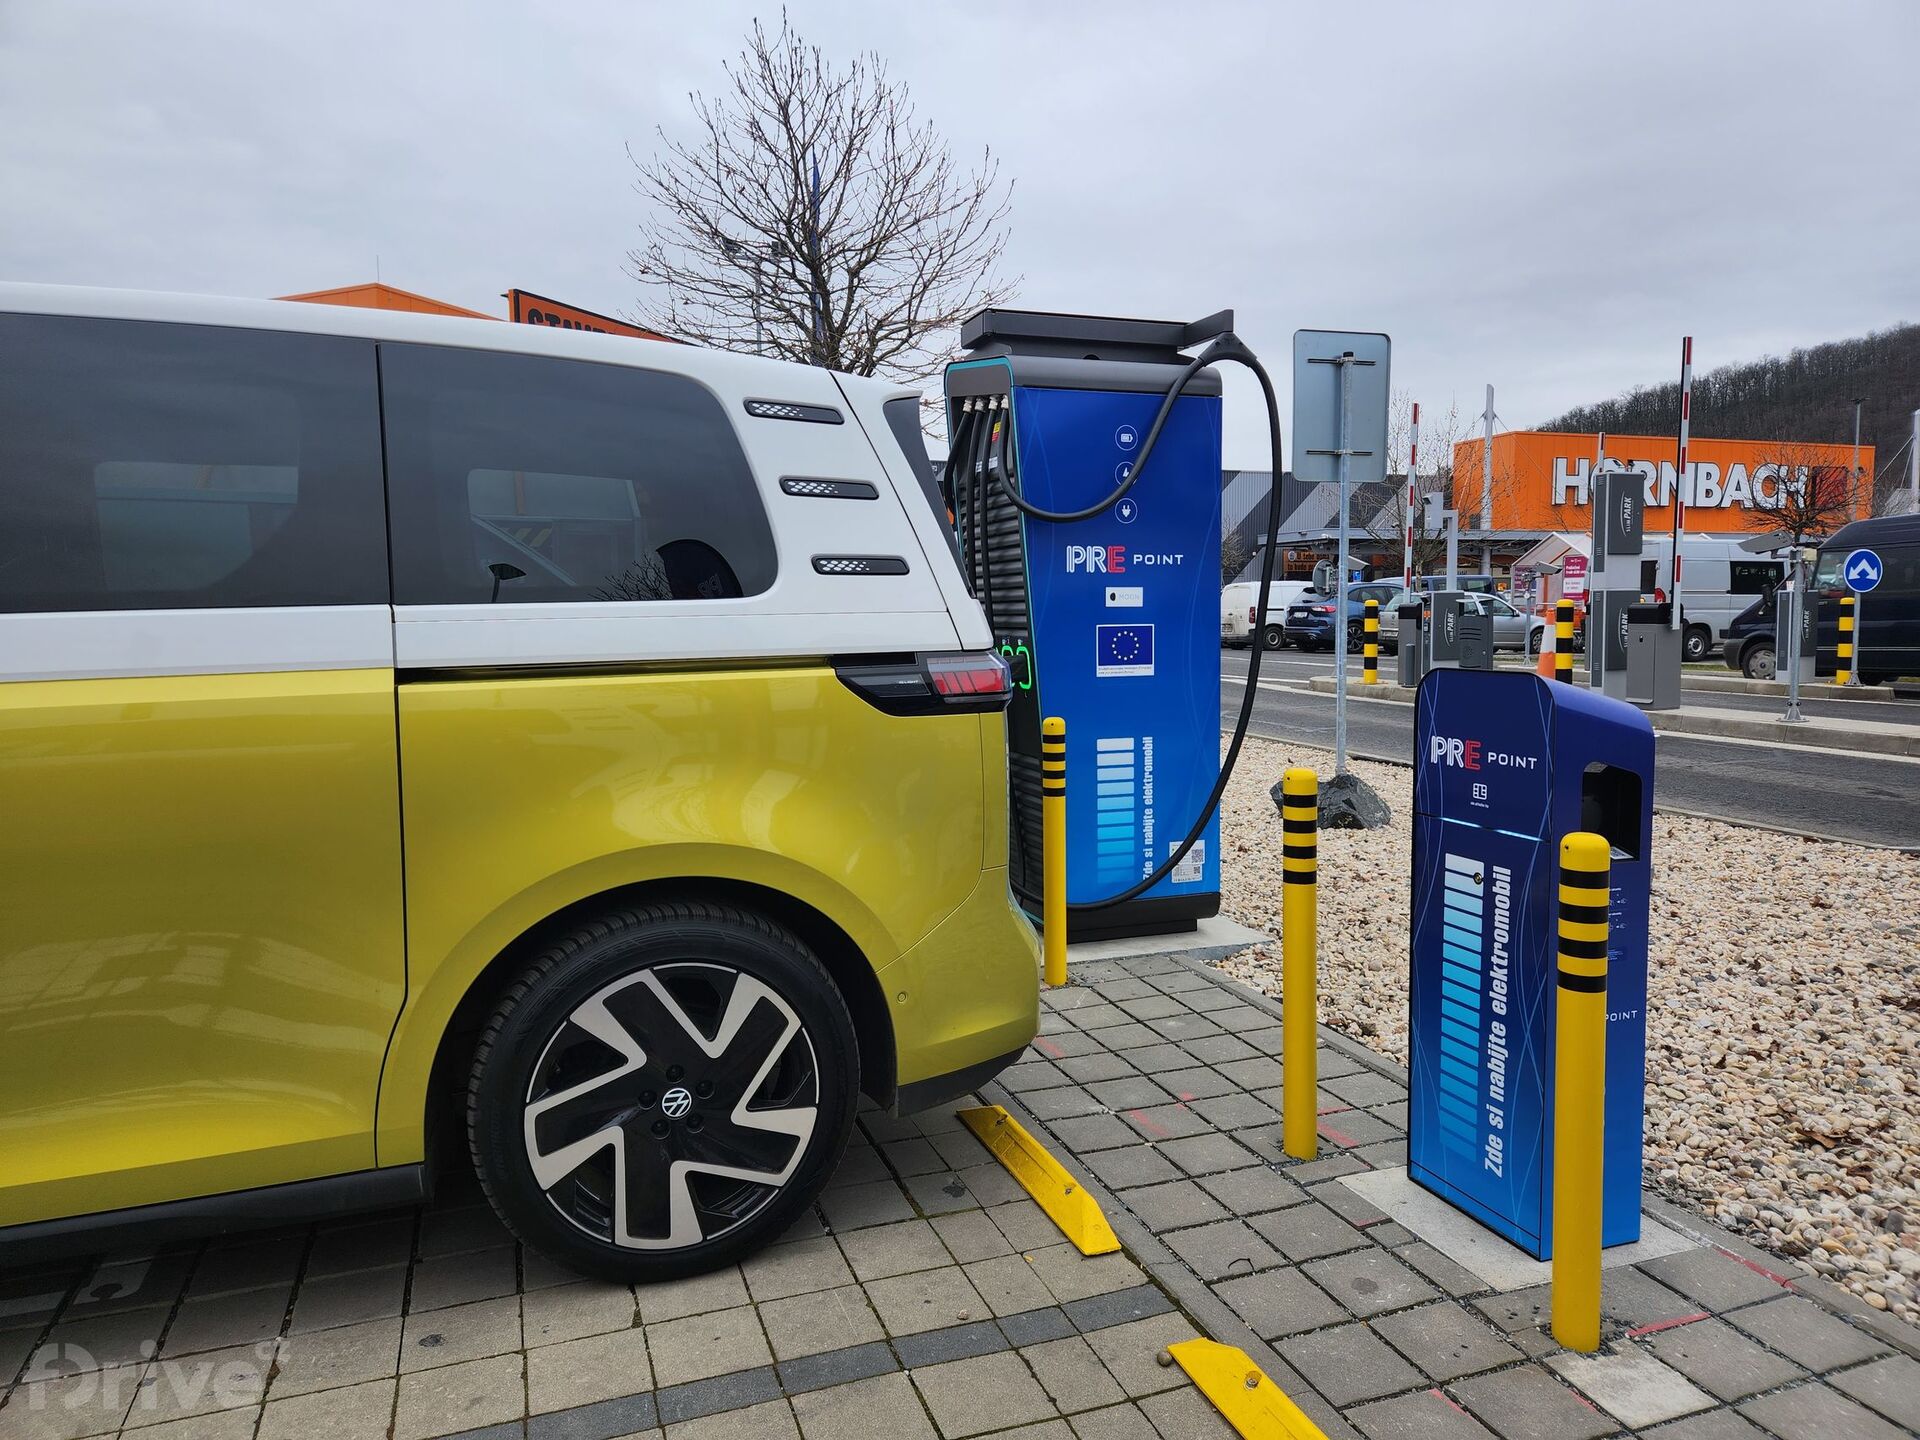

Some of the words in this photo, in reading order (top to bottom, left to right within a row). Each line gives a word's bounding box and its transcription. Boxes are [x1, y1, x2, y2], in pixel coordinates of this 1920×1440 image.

[1066, 545, 1125, 573] PRE
[1133, 554, 1184, 565] POINT
[1142, 736, 1153, 805] elektromobil
[1430, 735, 1481, 771] PRE
[1487, 751, 1538, 770] POINT
[1142, 808, 1155, 845] nabijte
[1143, 847, 1153, 858] si
[1489, 865, 1511, 1016] elektromobil
[1487, 1020, 1509, 1103] nabijte
[1486, 1103, 1504, 1130] si
[1485, 1131, 1502, 1180] Zde
